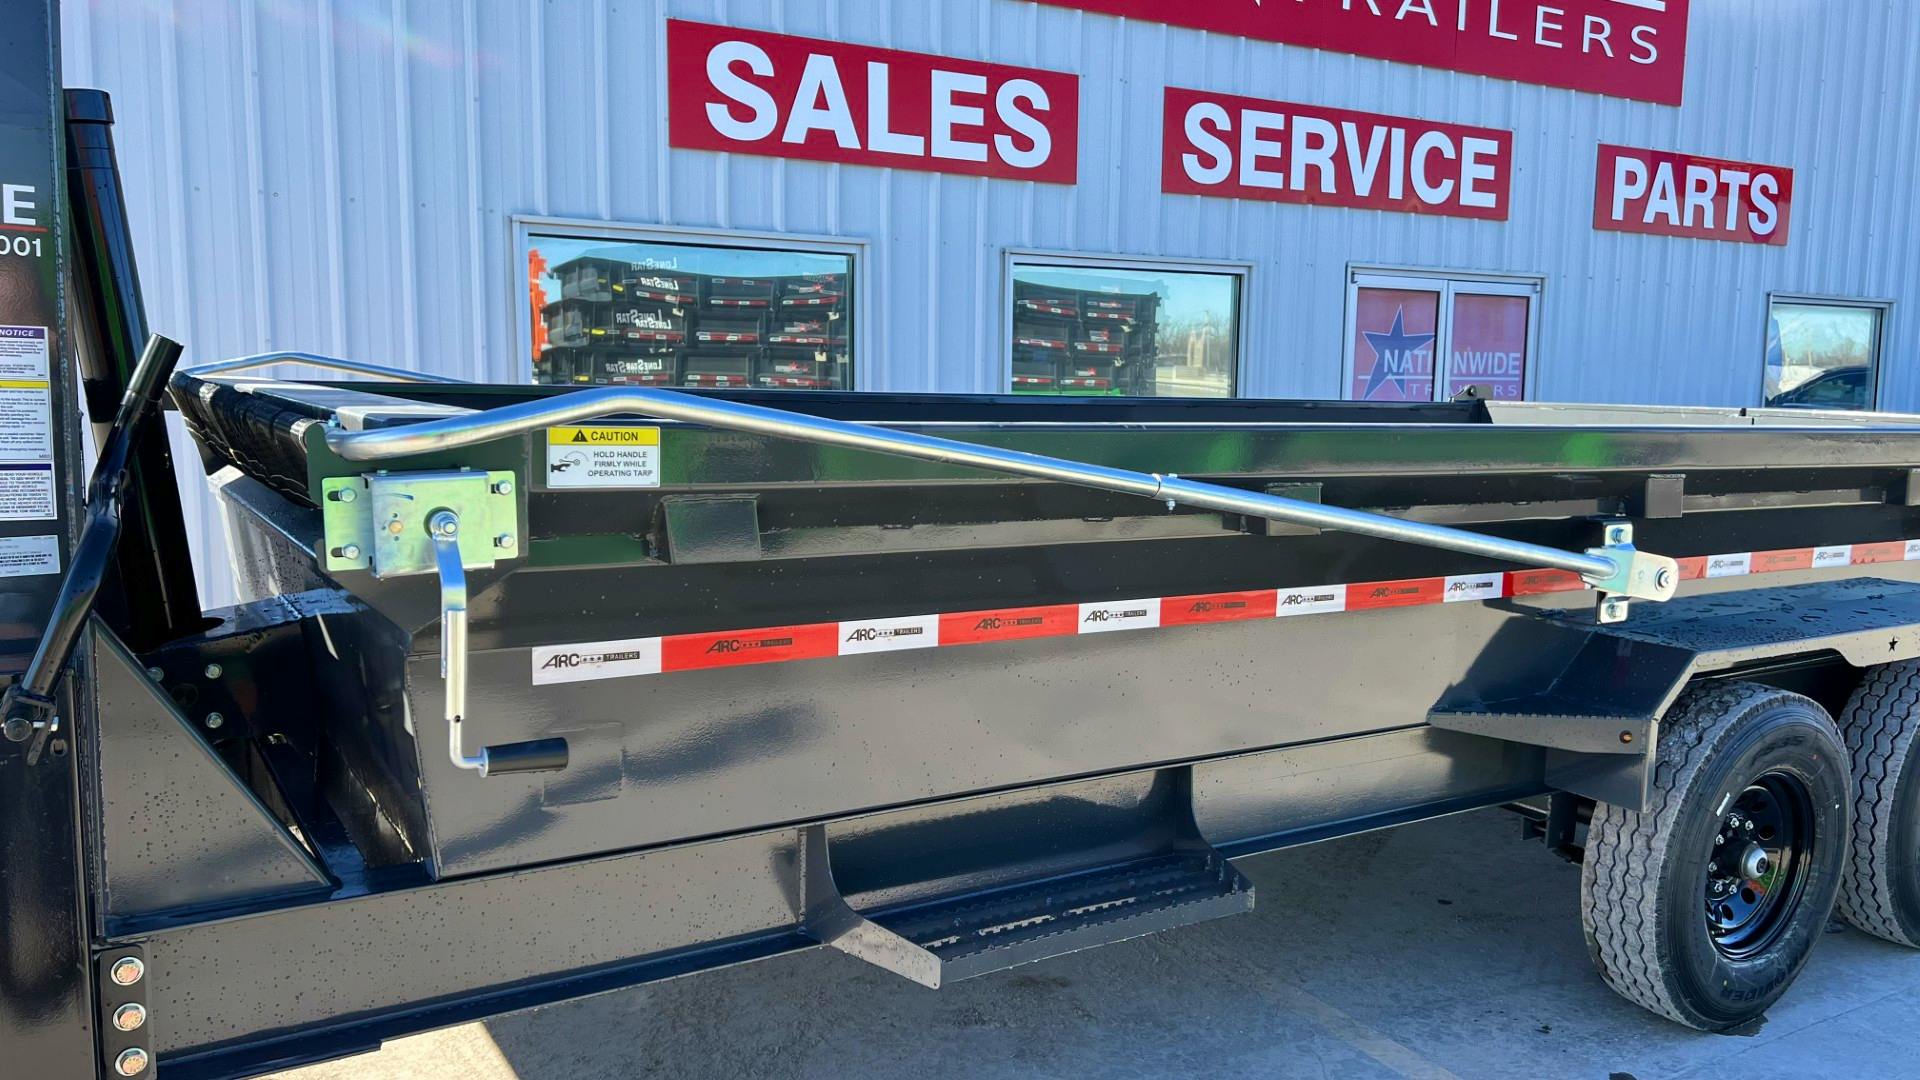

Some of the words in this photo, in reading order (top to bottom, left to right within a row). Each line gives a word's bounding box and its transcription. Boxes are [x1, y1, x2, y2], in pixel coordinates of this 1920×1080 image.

[705, 40, 1052, 168] SALES
[1182, 102, 1499, 208] SERVICE
[1611, 155, 1779, 235] PARTS
[0, 328, 35, 337] NOTICE
[1384, 348, 1521, 375] NATINWIDE
[591, 431, 638, 441] CAUTION
[593, 451, 615, 459] HOLD
[616, 451, 647, 459] HANDLE
[594, 460, 621, 468] FIRMLY
[623, 460, 647, 468] WHILE
[587, 469, 632, 477] OPERATING
[634, 469, 653, 477] TARP
[1369, 588, 1390, 598] ARC
[1448, 582, 1467, 592] ARC
[1281, 594, 1303, 606] ARC
[1084, 610, 1109, 622] ARC
[974, 617, 1001, 630] ARC
[846, 628, 876, 643] ARC
[705, 639, 740, 655] ARC
[541, 653, 580, 670] ARC
[604, 651, 640, 662] TRAILERS
